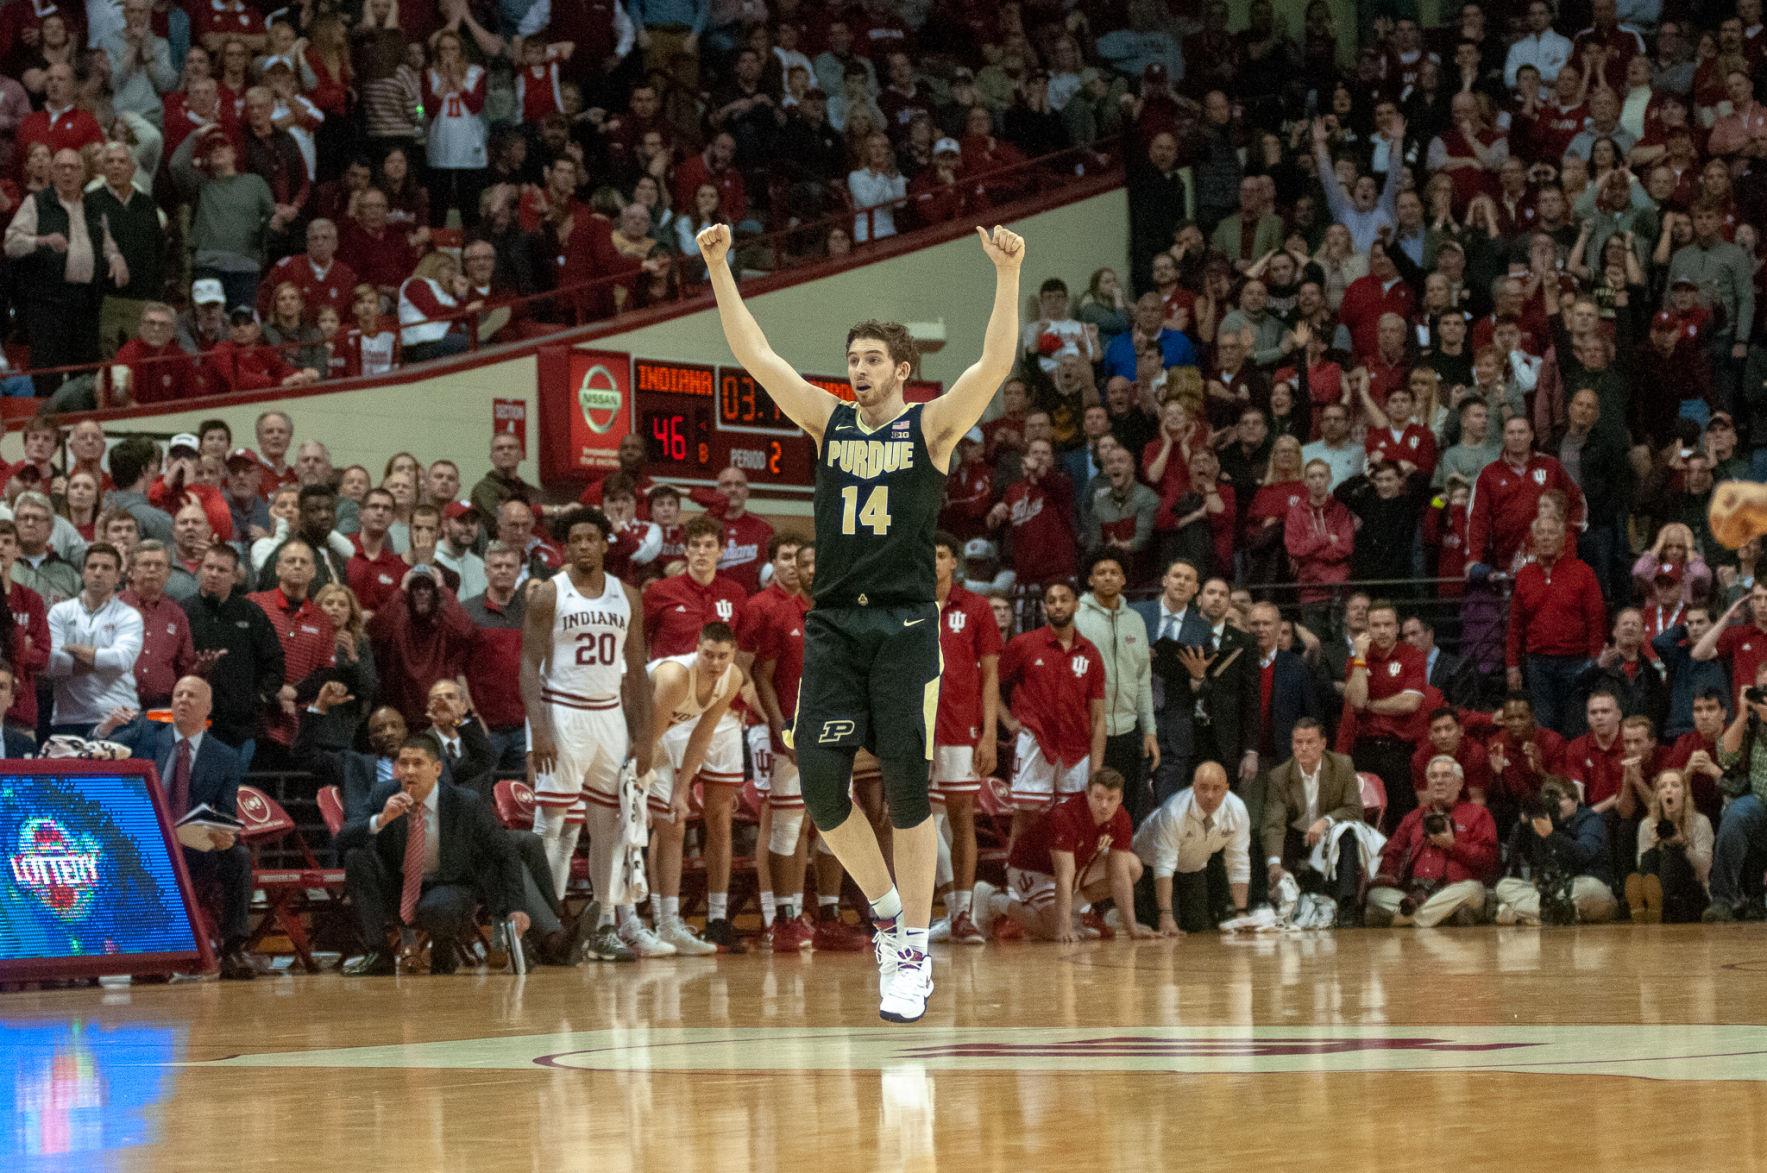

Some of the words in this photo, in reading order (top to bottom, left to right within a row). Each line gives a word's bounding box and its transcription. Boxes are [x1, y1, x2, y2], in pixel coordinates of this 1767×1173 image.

[638, 365, 713, 396] INDIANA
[583, 393, 617, 405] NISSAN
[653, 415, 686, 461] 46
[769, 440, 782, 474] 2
[827, 440, 914, 480] PURDUE
[841, 485, 892, 535] 14
[562, 610, 626, 632] INDIANA
[575, 632, 616, 667] 20
[818, 720, 855, 743] P
[10, 854, 99, 885] LOTTERY
